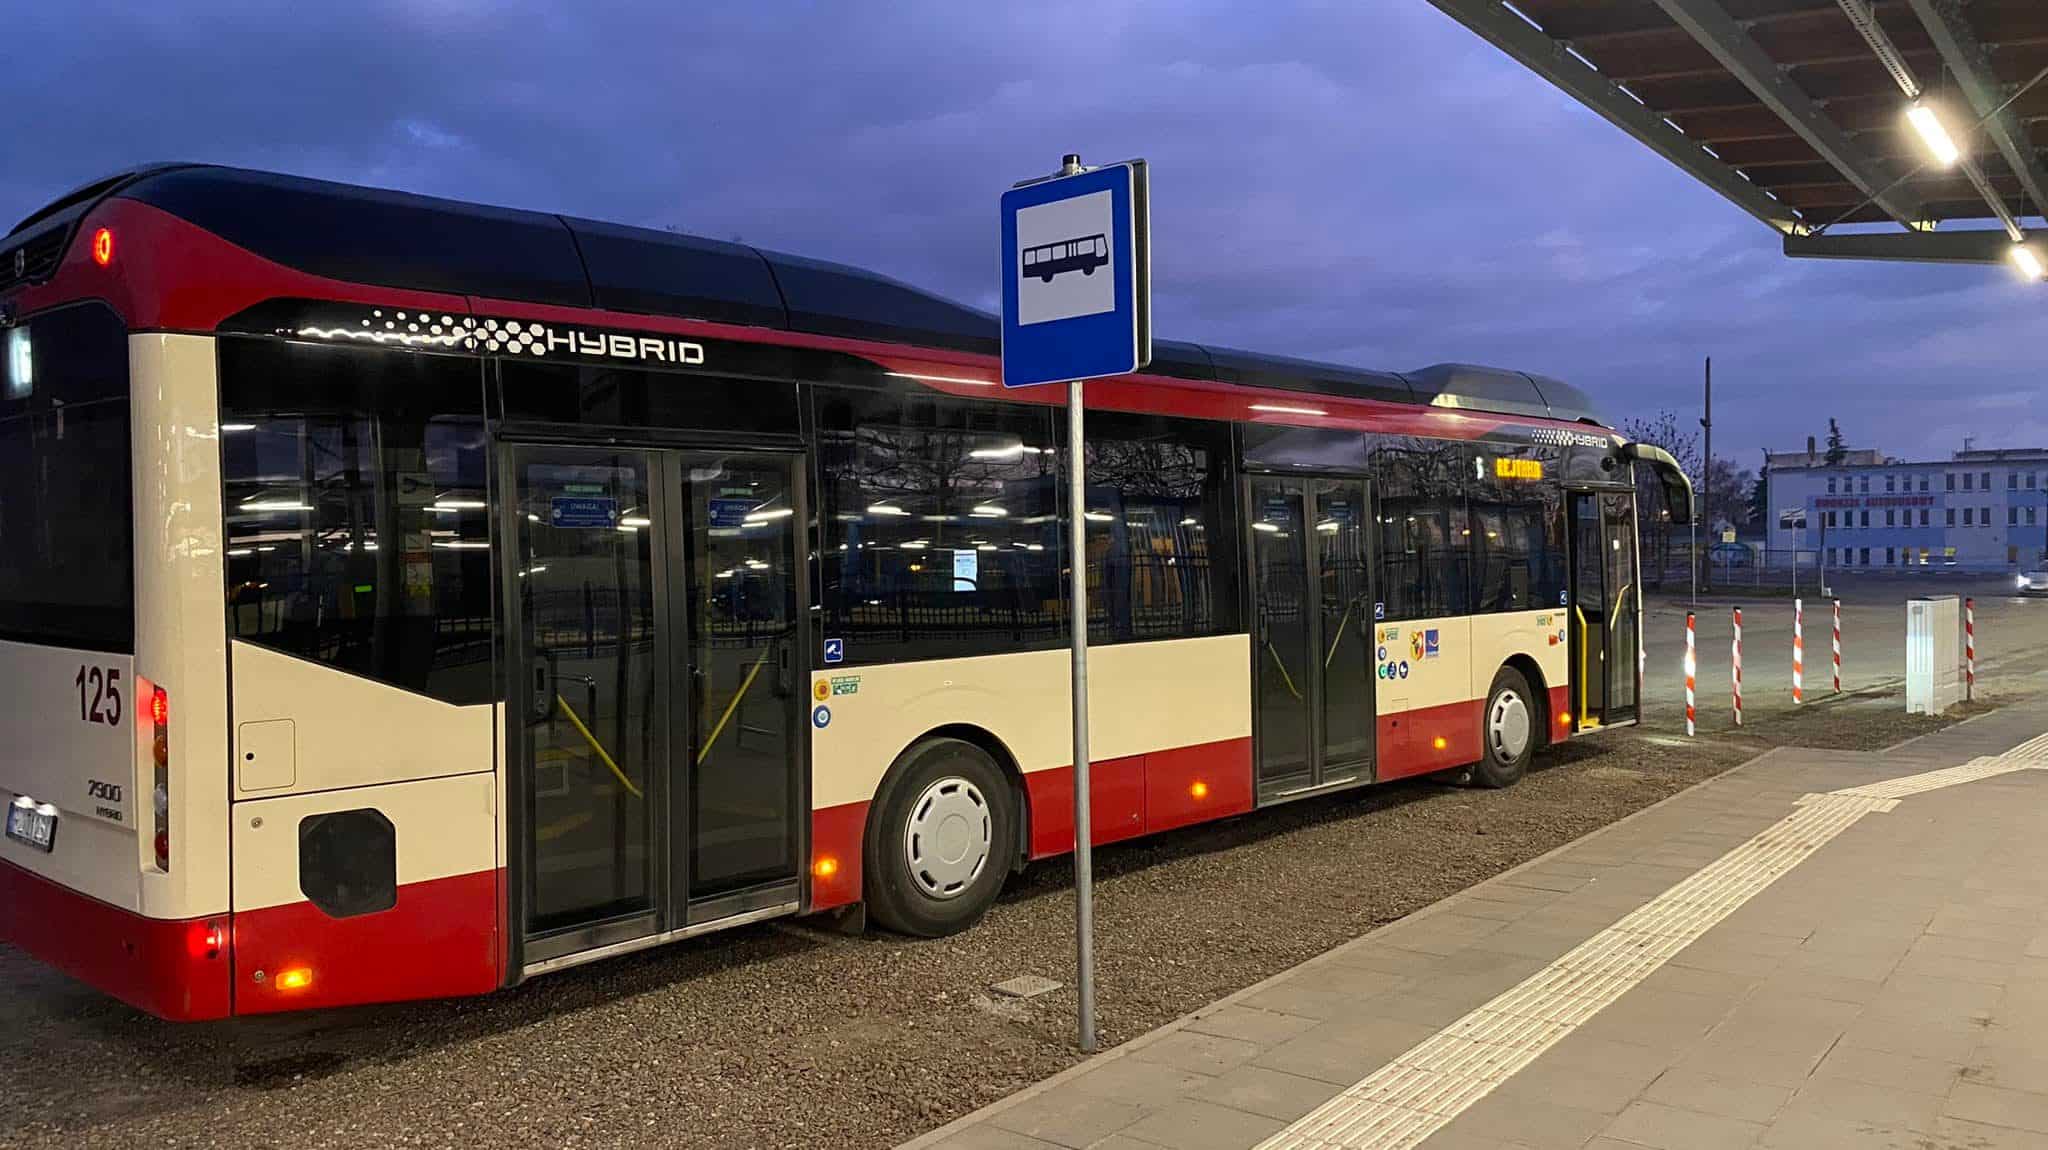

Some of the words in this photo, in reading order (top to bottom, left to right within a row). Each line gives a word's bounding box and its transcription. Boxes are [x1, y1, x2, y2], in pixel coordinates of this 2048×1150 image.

[547, 328, 704, 364] HYBRID
[1571, 434, 1608, 448] HYBRID
[75, 664, 121, 726] 125
[88, 780, 122, 802] 7900
